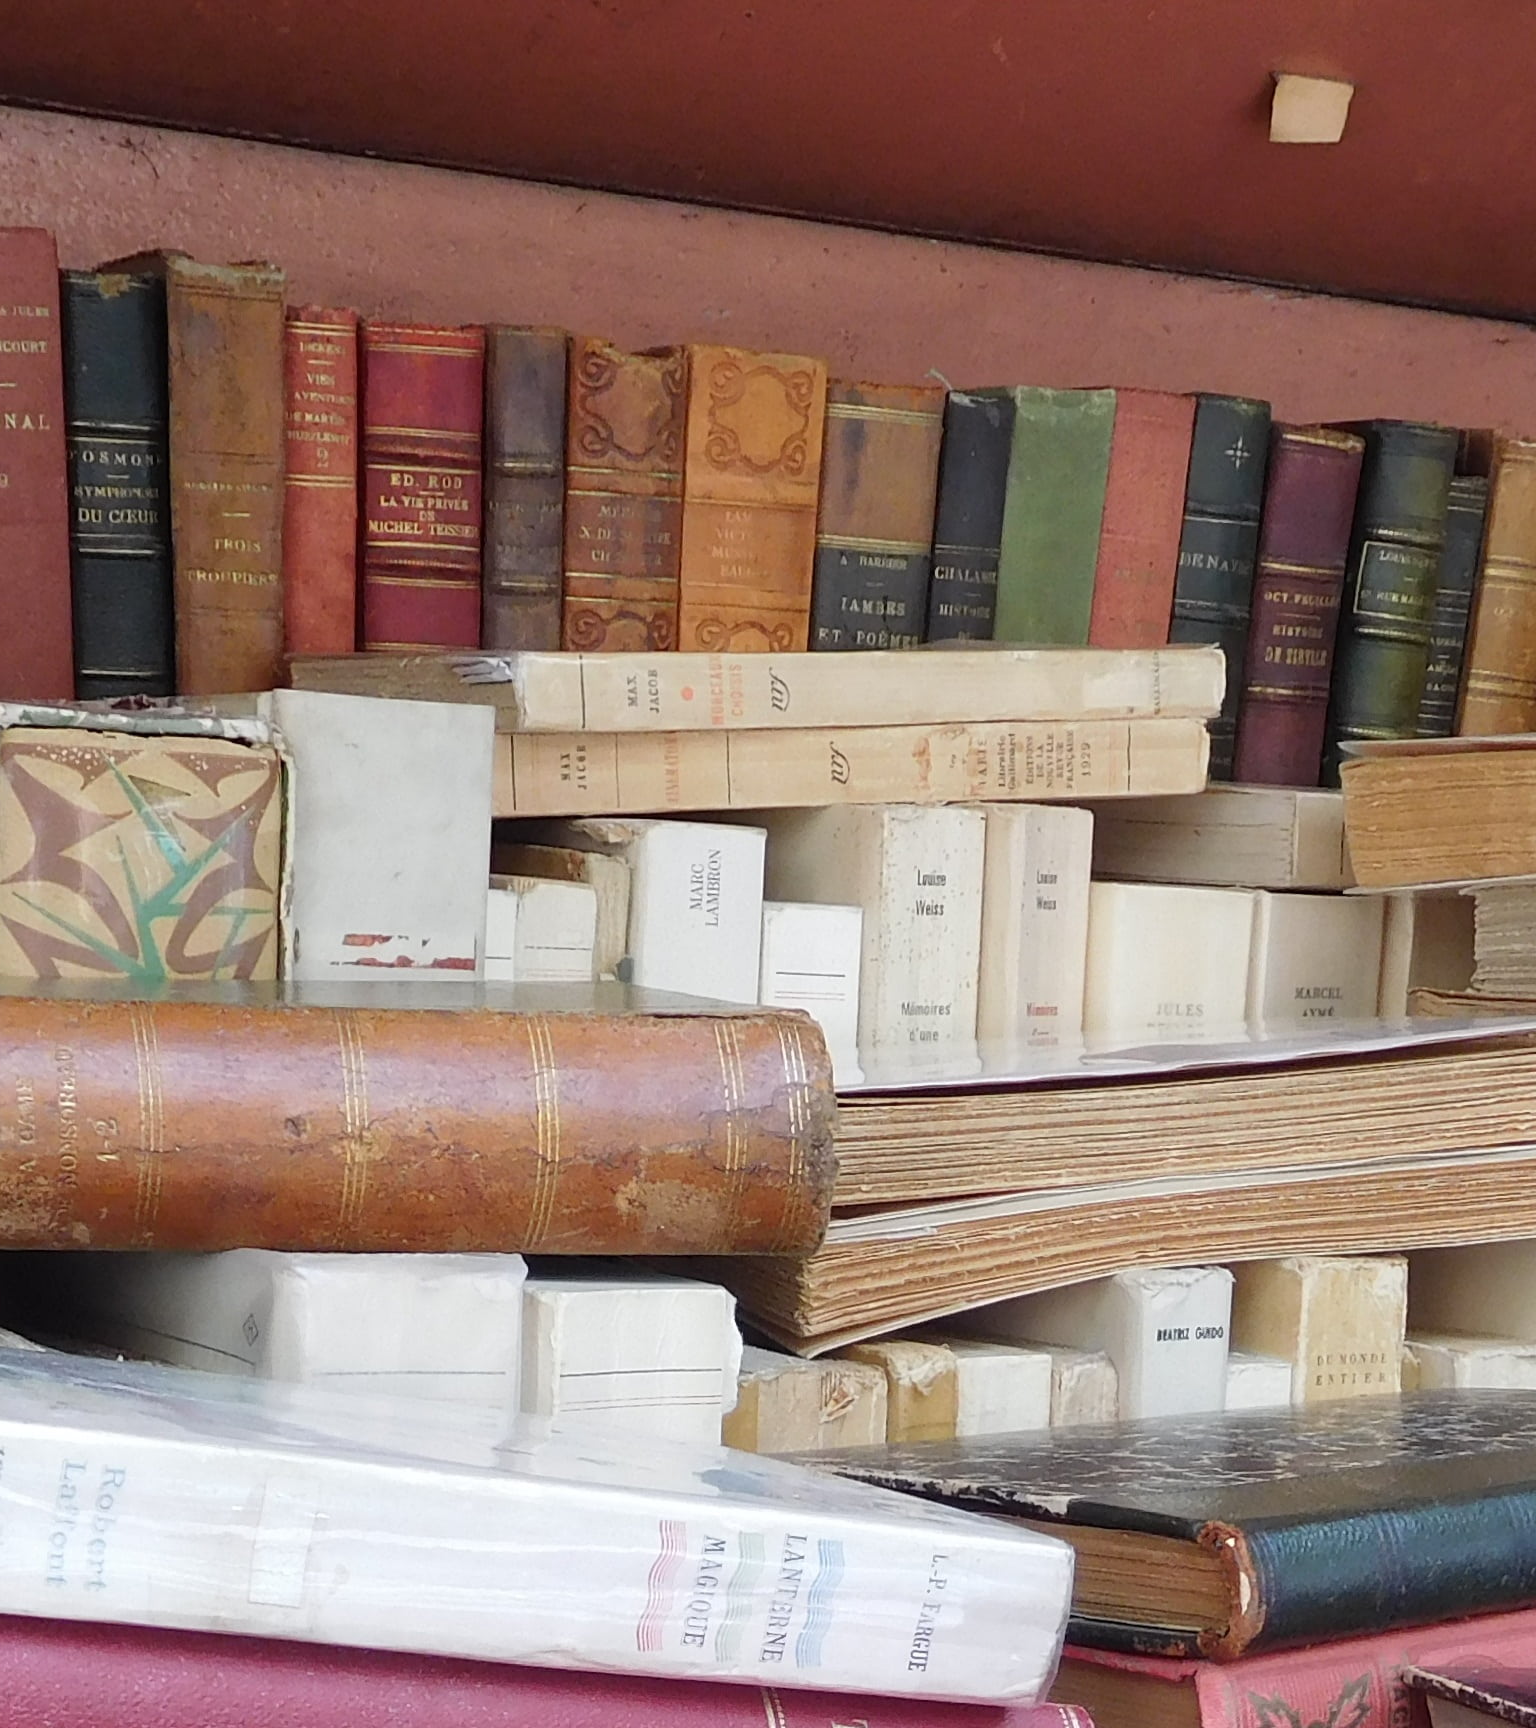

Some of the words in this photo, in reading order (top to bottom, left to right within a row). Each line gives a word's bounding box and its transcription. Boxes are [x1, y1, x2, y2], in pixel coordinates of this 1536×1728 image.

[427, 473, 464, 491] ROD
[379, 494, 399, 508] LA
[77, 506, 104, 524] DU
[367, 519, 424, 537] MICHEL
[626, 674, 639, 708] MAX
[689, 863, 706, 912] MARC
[916, 867, 948, 889] Louise
[705, 848, 722, 928] LAMBRON
[914, 899, 946, 918] Weiss
[1293, 986, 1344, 1002] MARCEL
[1154, 1002, 1205, 1018] JULES
[1194, 1325, 1225, 1341] GUIDO
[1338, 1351, 1388, 1366] MONDE
[1314, 1371, 1388, 1387] ENTIER
[86, 1461, 128, 1593] Robert
[928, 1553, 950, 1595] L.-P.
[679, 1534, 727, 1650] MAGIQUE
[758, 1531, 810, 1667] LANTERNE
[907, 1602, 947, 1674] FARGUE
